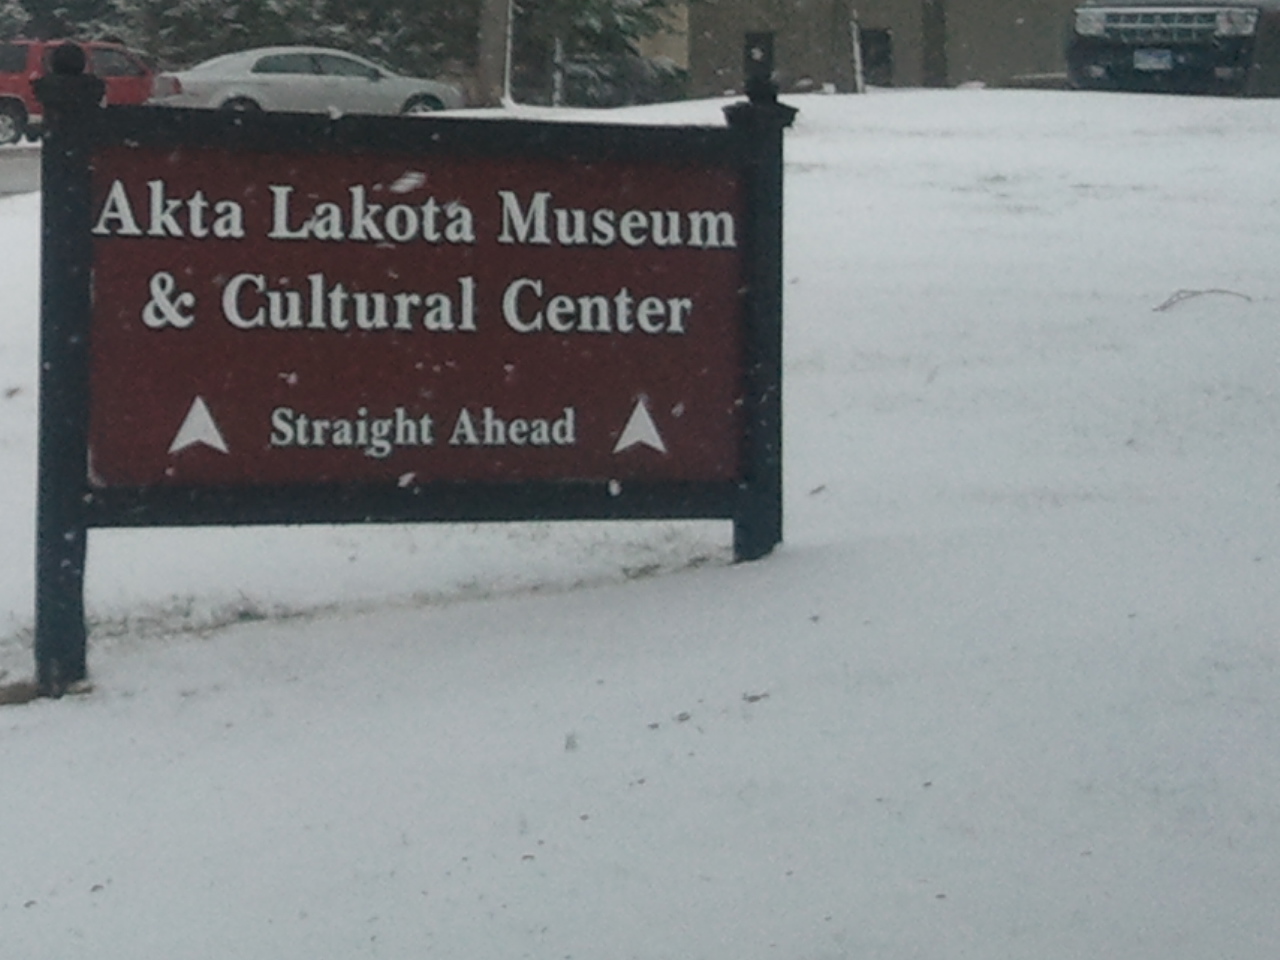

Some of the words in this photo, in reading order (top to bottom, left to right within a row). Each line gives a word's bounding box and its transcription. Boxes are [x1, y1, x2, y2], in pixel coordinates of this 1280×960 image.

[92, 180, 244, 237] Akta
[269, 186, 475, 242] Lakota
[498, 191, 736, 248] Museum
[142, 272, 195, 328] &
[222, 274, 476, 332] Cultural
[502, 279, 693, 334] Center
[270, 407, 433, 457] Straight
[449, 407, 576, 445] Ahead
